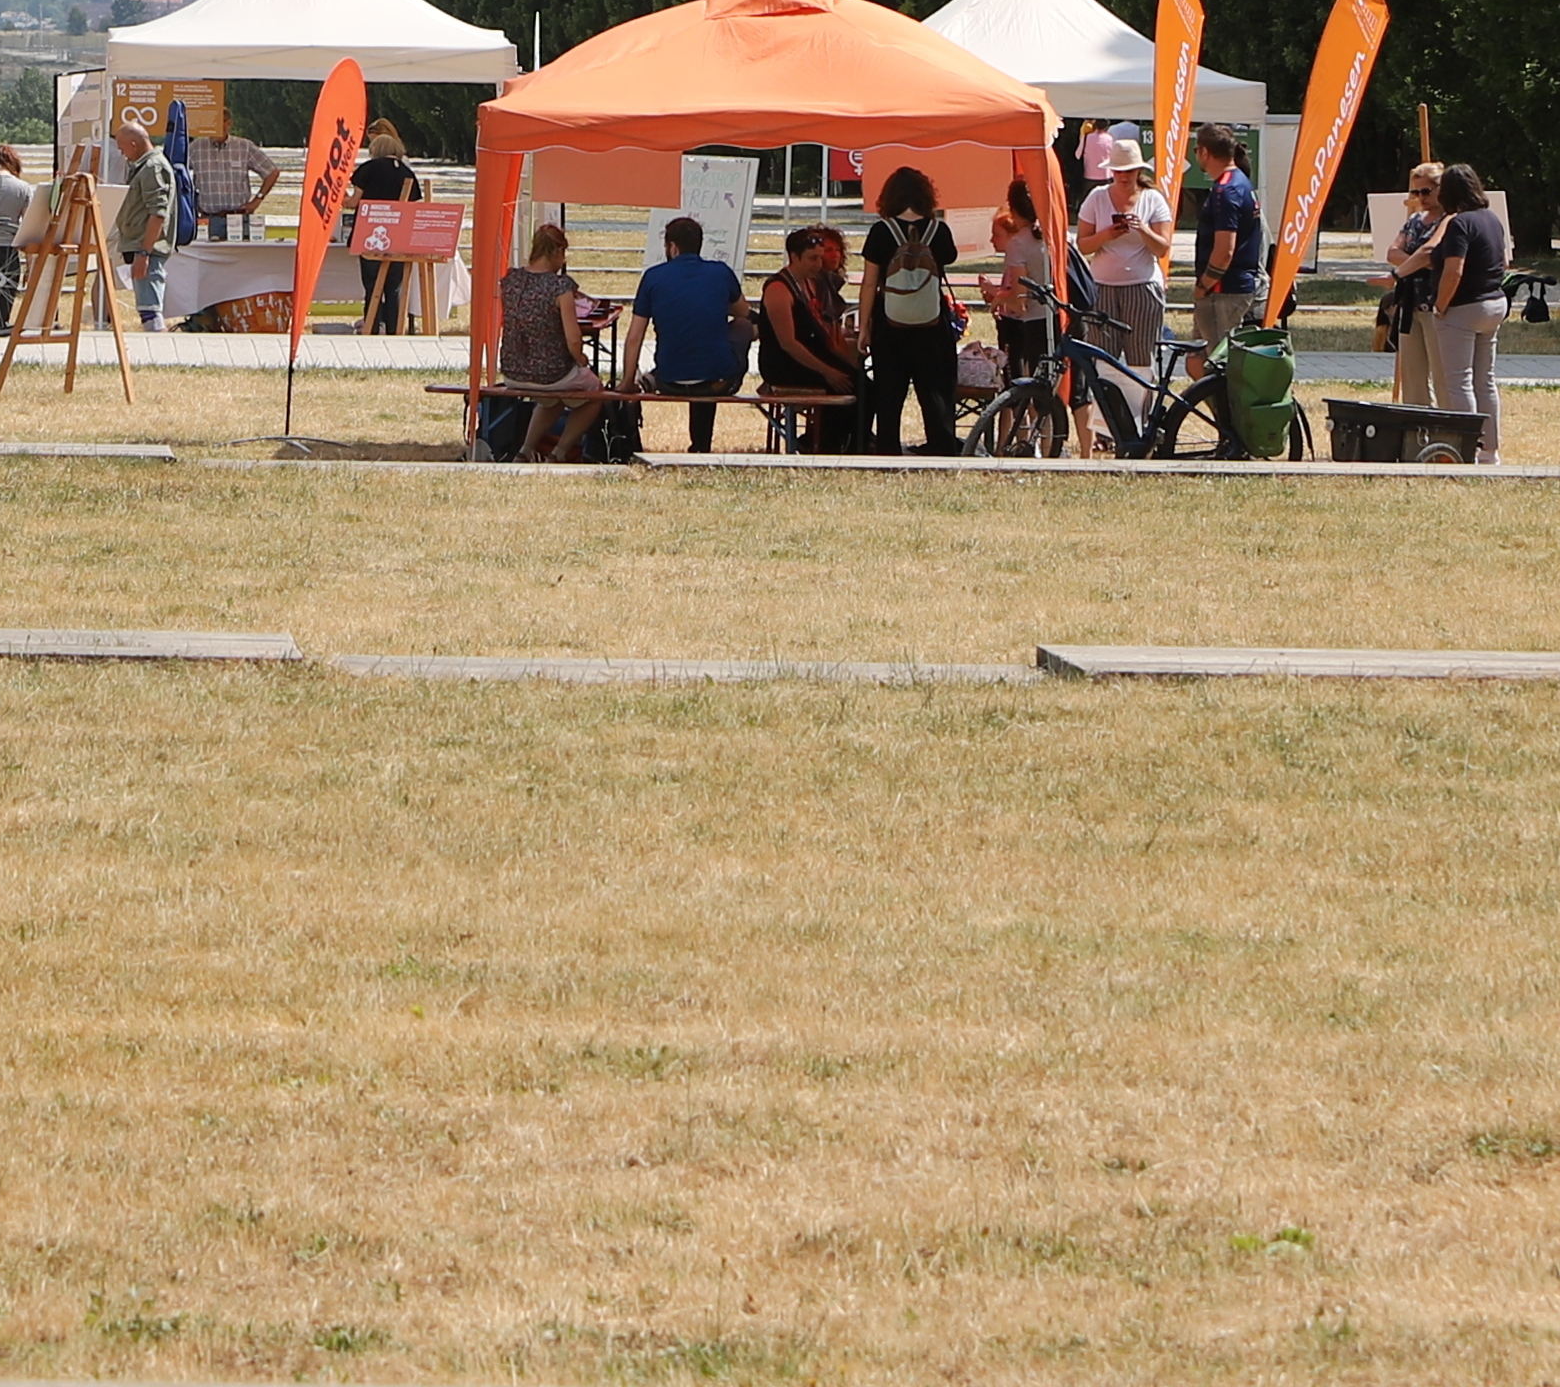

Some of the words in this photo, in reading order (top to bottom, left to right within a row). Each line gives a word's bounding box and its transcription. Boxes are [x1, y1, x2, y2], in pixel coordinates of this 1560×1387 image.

[115, 83, 127, 97] 12
[1142, 130, 1154, 144] 13
[339, 136, 356, 174] Welt
[311, 117, 350, 220] Brot
[684, 171, 740, 188] ORKSHOP
[683, 188, 719, 209] REA
[361, 203, 369, 217] 9
